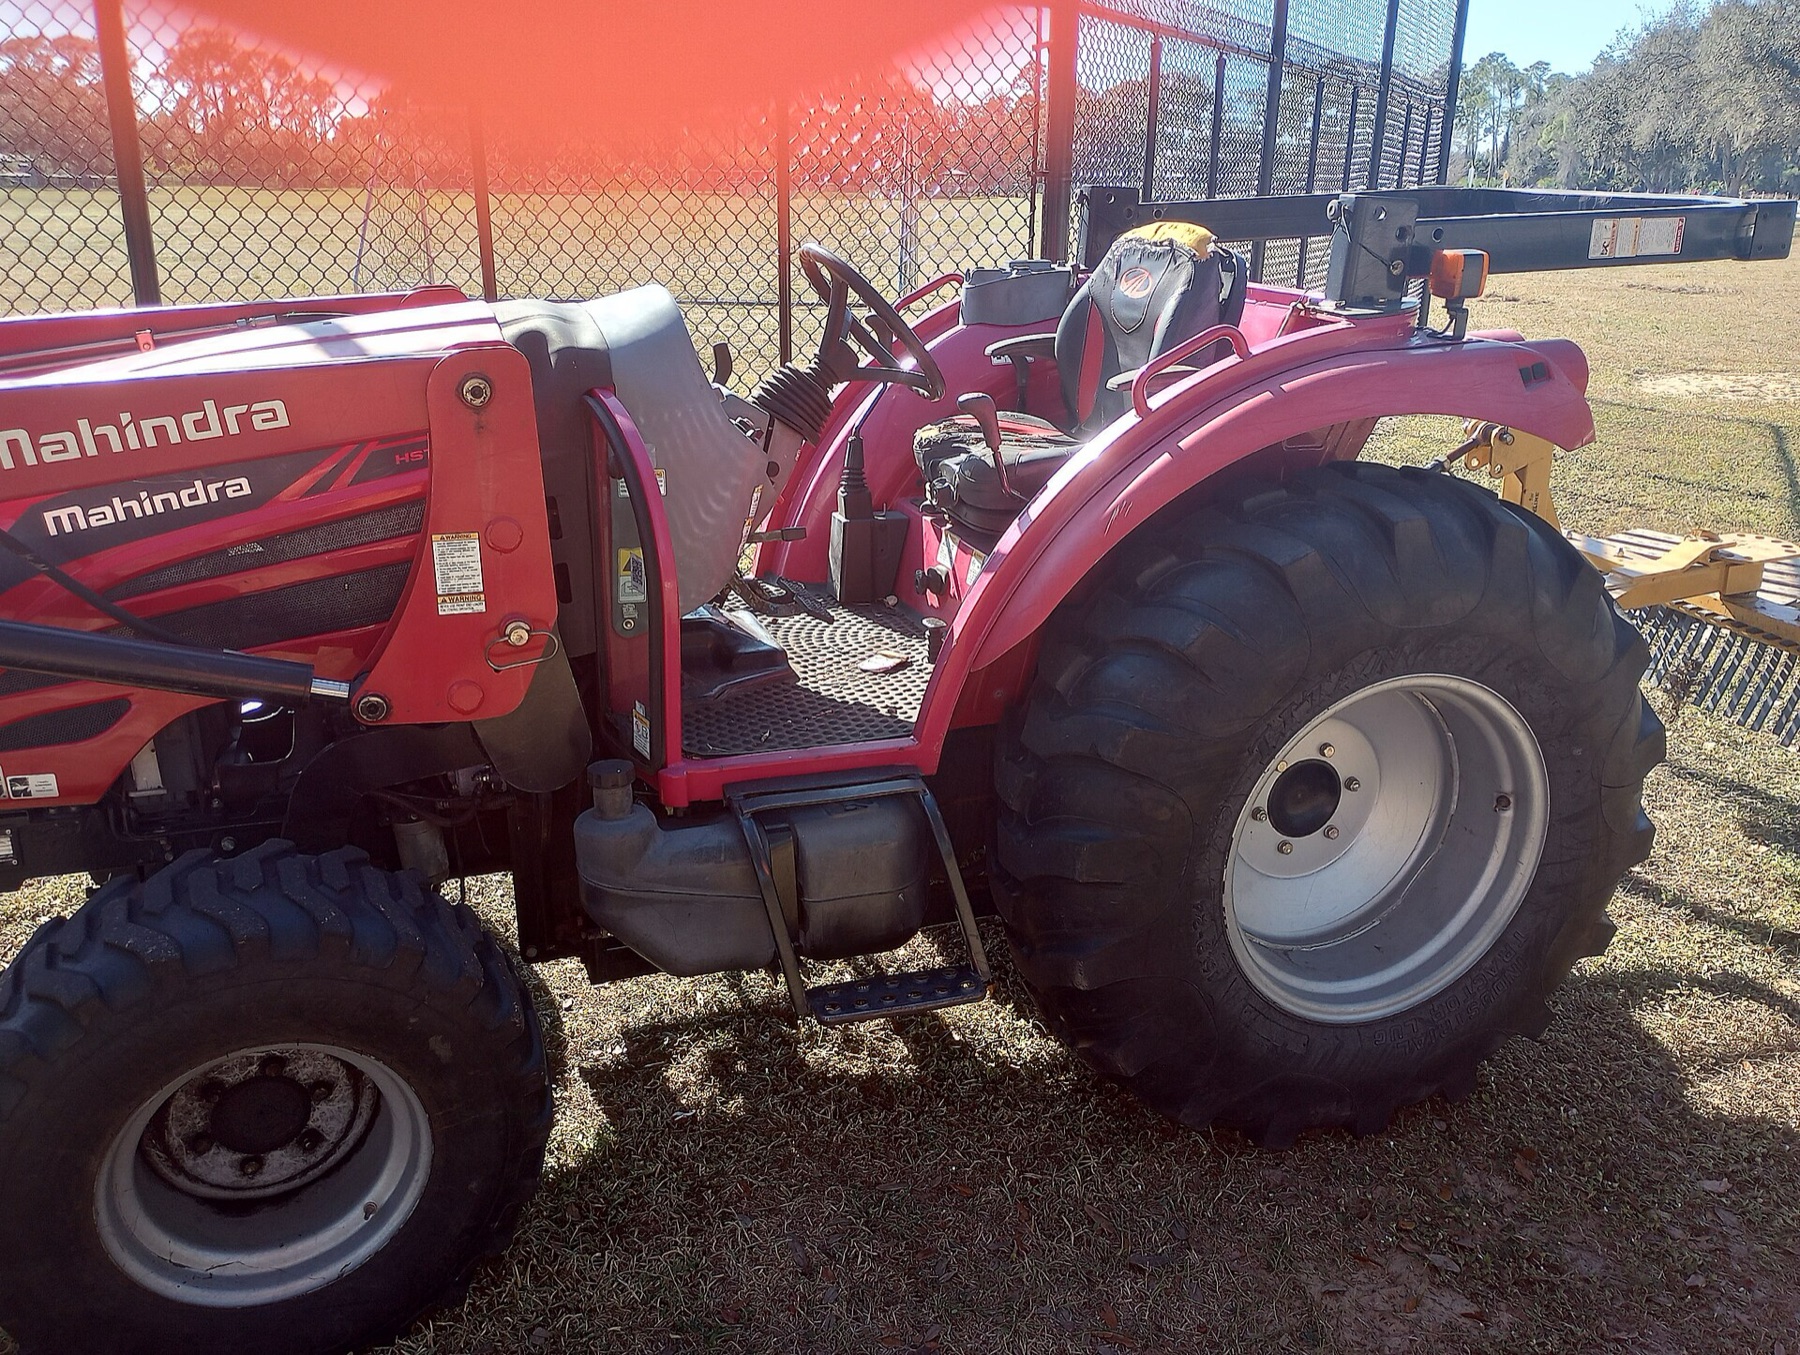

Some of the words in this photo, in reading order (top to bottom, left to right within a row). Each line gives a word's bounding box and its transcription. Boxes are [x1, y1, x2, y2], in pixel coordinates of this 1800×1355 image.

[43, 476, 252, 536] Mahindra
[449, 594, 482, 603] WARNING
[1396, 955, 1530, 1056] INDUSTRIAL
[1429, 930, 1529, 1022] TRACTOR
[1373, 1018, 1419, 1046] LUG
